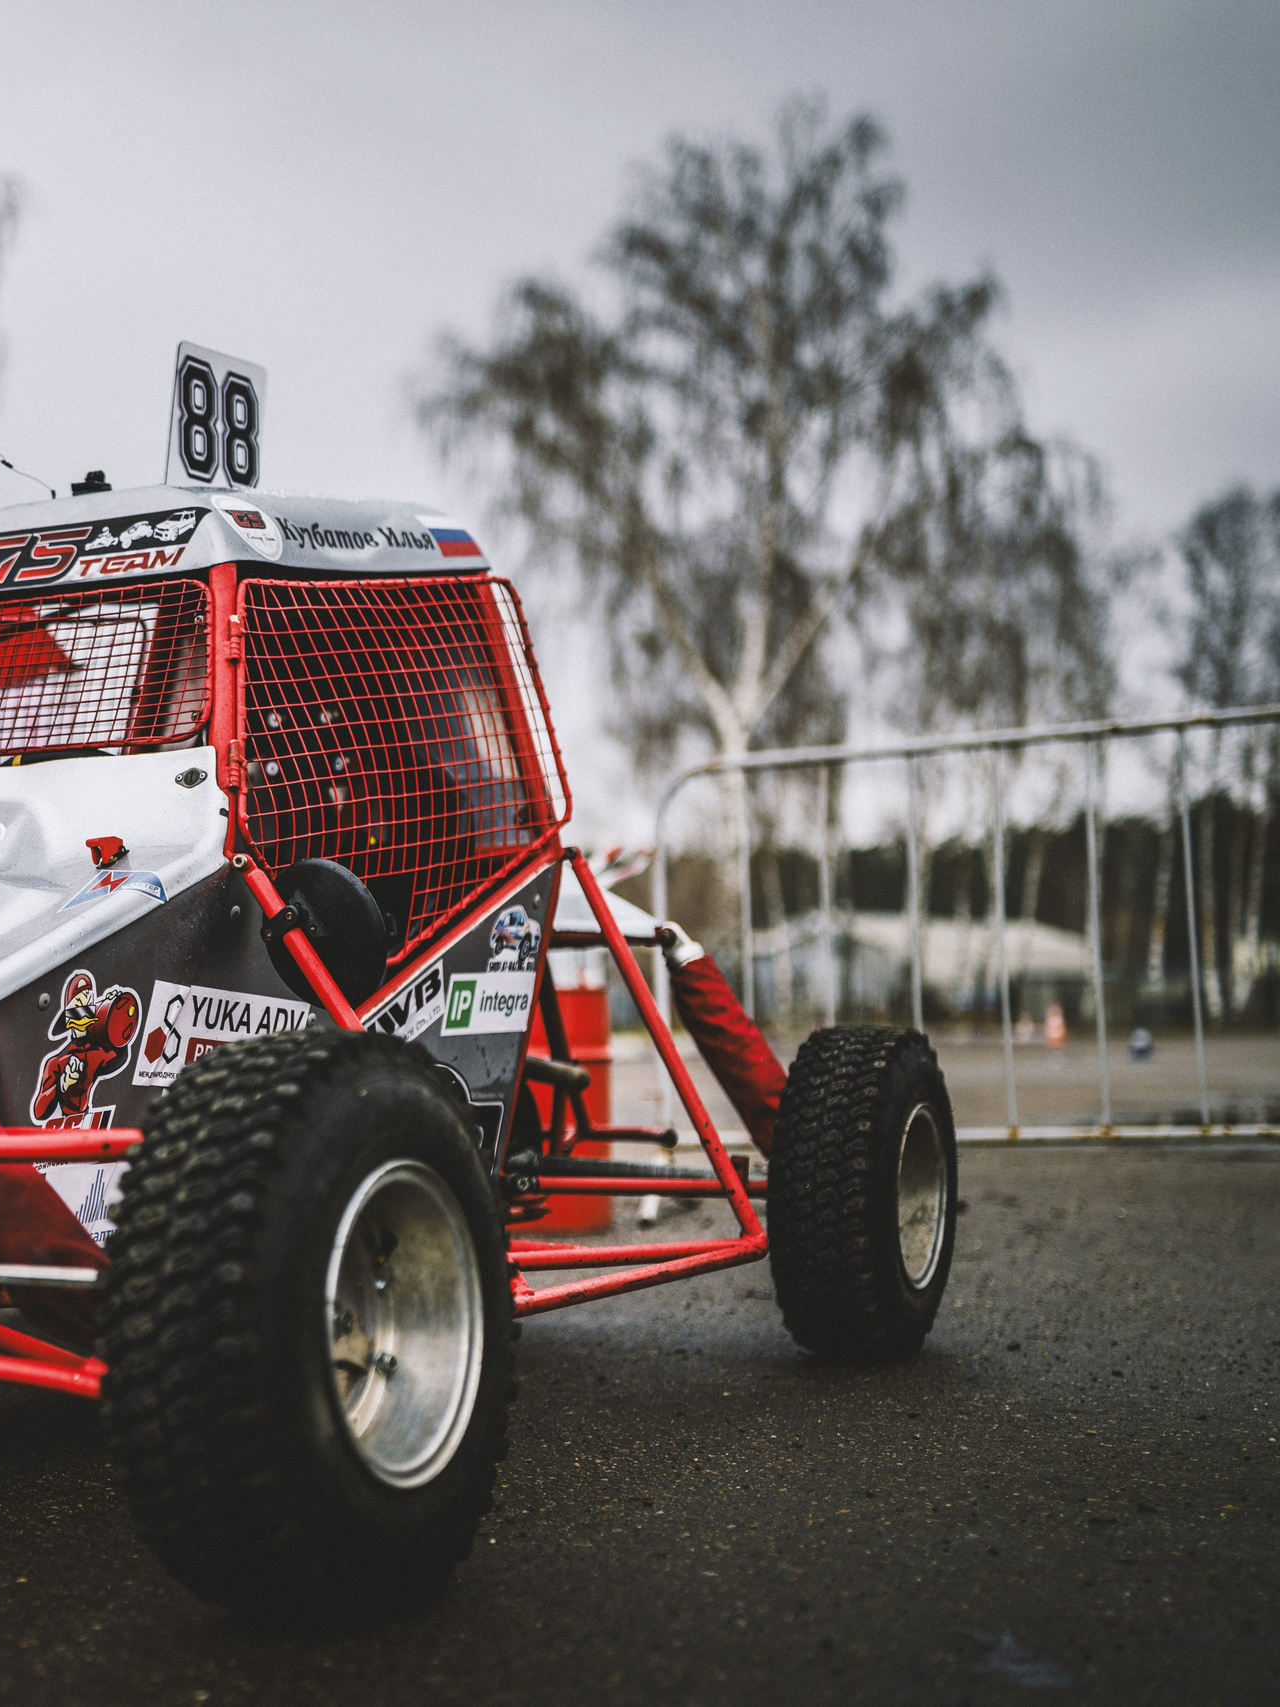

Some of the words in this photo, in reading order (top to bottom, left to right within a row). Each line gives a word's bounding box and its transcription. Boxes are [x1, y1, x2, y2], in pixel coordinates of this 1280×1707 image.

[179, 354, 260, 488] 88
[228, 510, 266, 529] GS
[275, 516, 380, 550] Курбатов
[377, 527, 436, 551] Илья
[79, 546, 186, 577] TEAM
[192, 995, 251, 1034] YUKA
[255, 1006, 306, 1034] ADV
[451, 990, 472, 1021] IP
[479, 990, 529, 1017] integra
